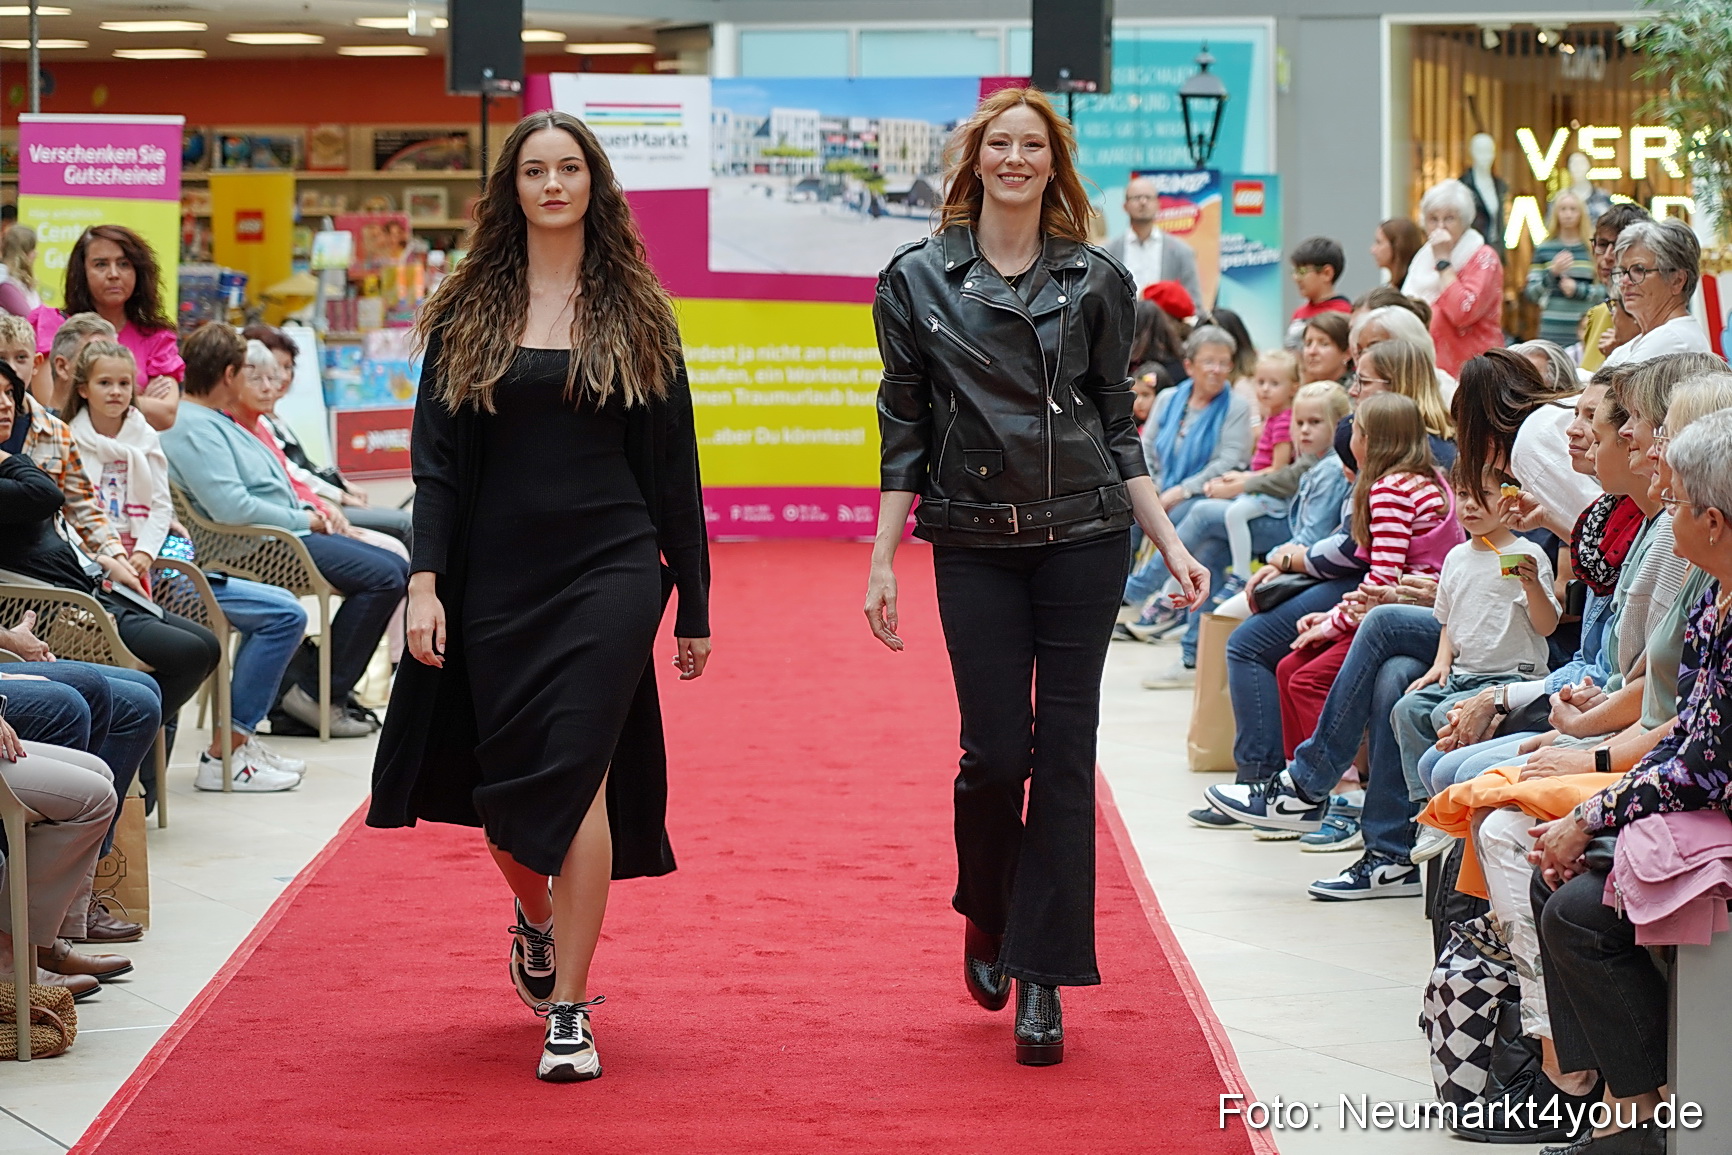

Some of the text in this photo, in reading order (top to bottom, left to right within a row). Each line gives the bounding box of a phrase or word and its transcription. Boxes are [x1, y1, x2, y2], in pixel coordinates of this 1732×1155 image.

[599, 131, 690, 148] uerMarkt
[29, 143, 167, 164] Verschenken Sie
[1516, 126, 1714, 181] VER
[64, 165, 167, 185] Gutscheine!
[1234, 189, 1265, 207] LEGO
[737, 343, 755, 366] ja
[756, 344, 801, 362] nicht
[804, 346, 827, 362] an
[754, 366, 785, 385] ein
[785, 366, 859, 385] Workout
[692, 387, 733, 406] inen
[734, 387, 845, 406] Traumurlaub
[755, 427, 781, 445] Du
[782, 427, 866, 446] könntest!
